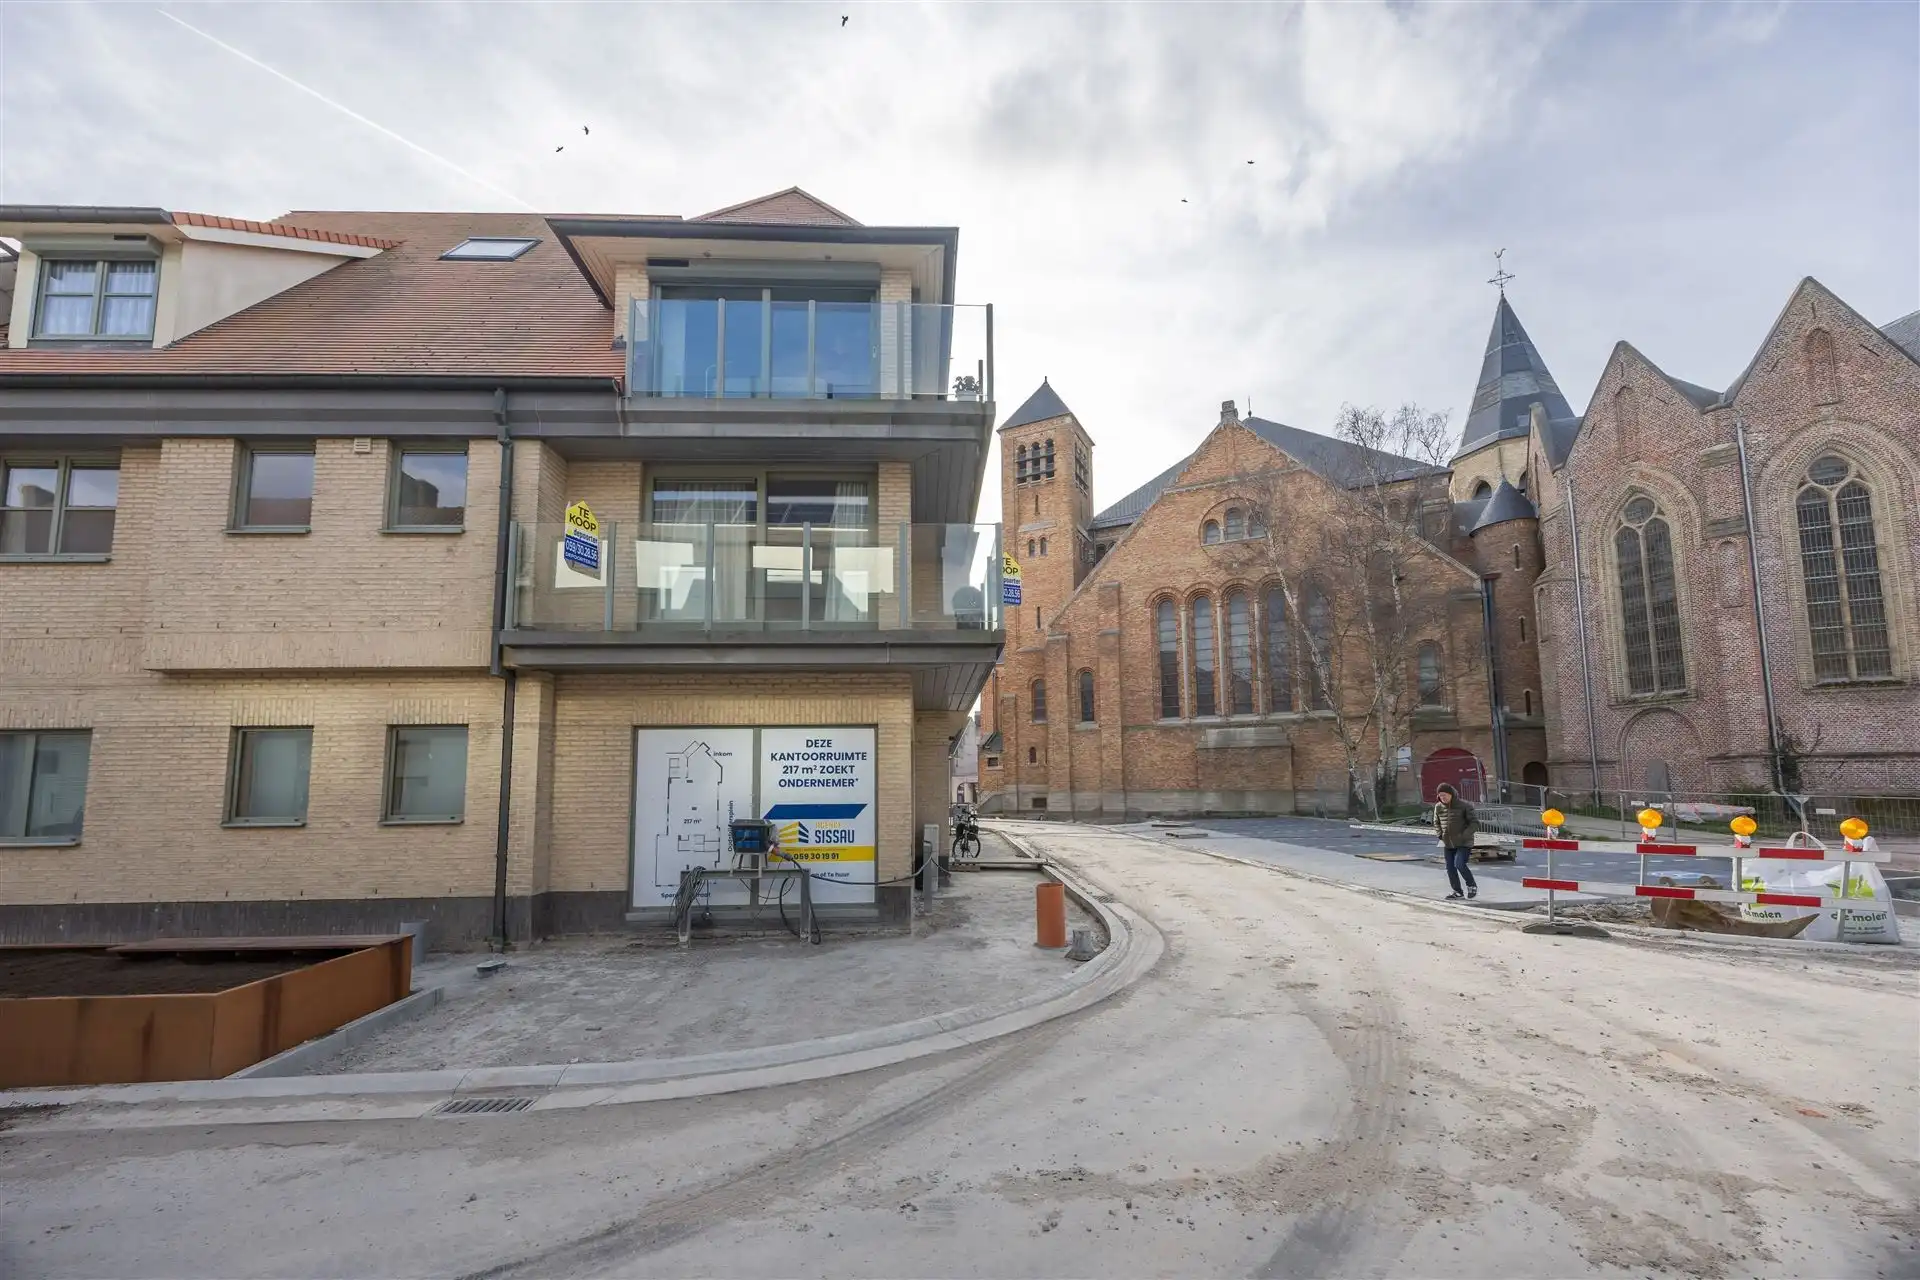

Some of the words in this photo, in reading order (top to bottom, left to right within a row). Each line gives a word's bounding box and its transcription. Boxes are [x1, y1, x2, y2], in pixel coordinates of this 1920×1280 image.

[578, 505, 590, 519] TE
[569, 513, 597, 531] KOOP
[805, 739, 833, 748] DEZE
[770, 752, 867, 761] KANTOORRUIMTE
[782, 765, 800, 774] 217
[801, 764, 818, 774] m²
[820, 765, 855, 774] ZOEKT
[814, 829, 855, 844] SISSAU
[1752, 910, 1782, 918] molen
[1852, 912, 1888, 922] molen
